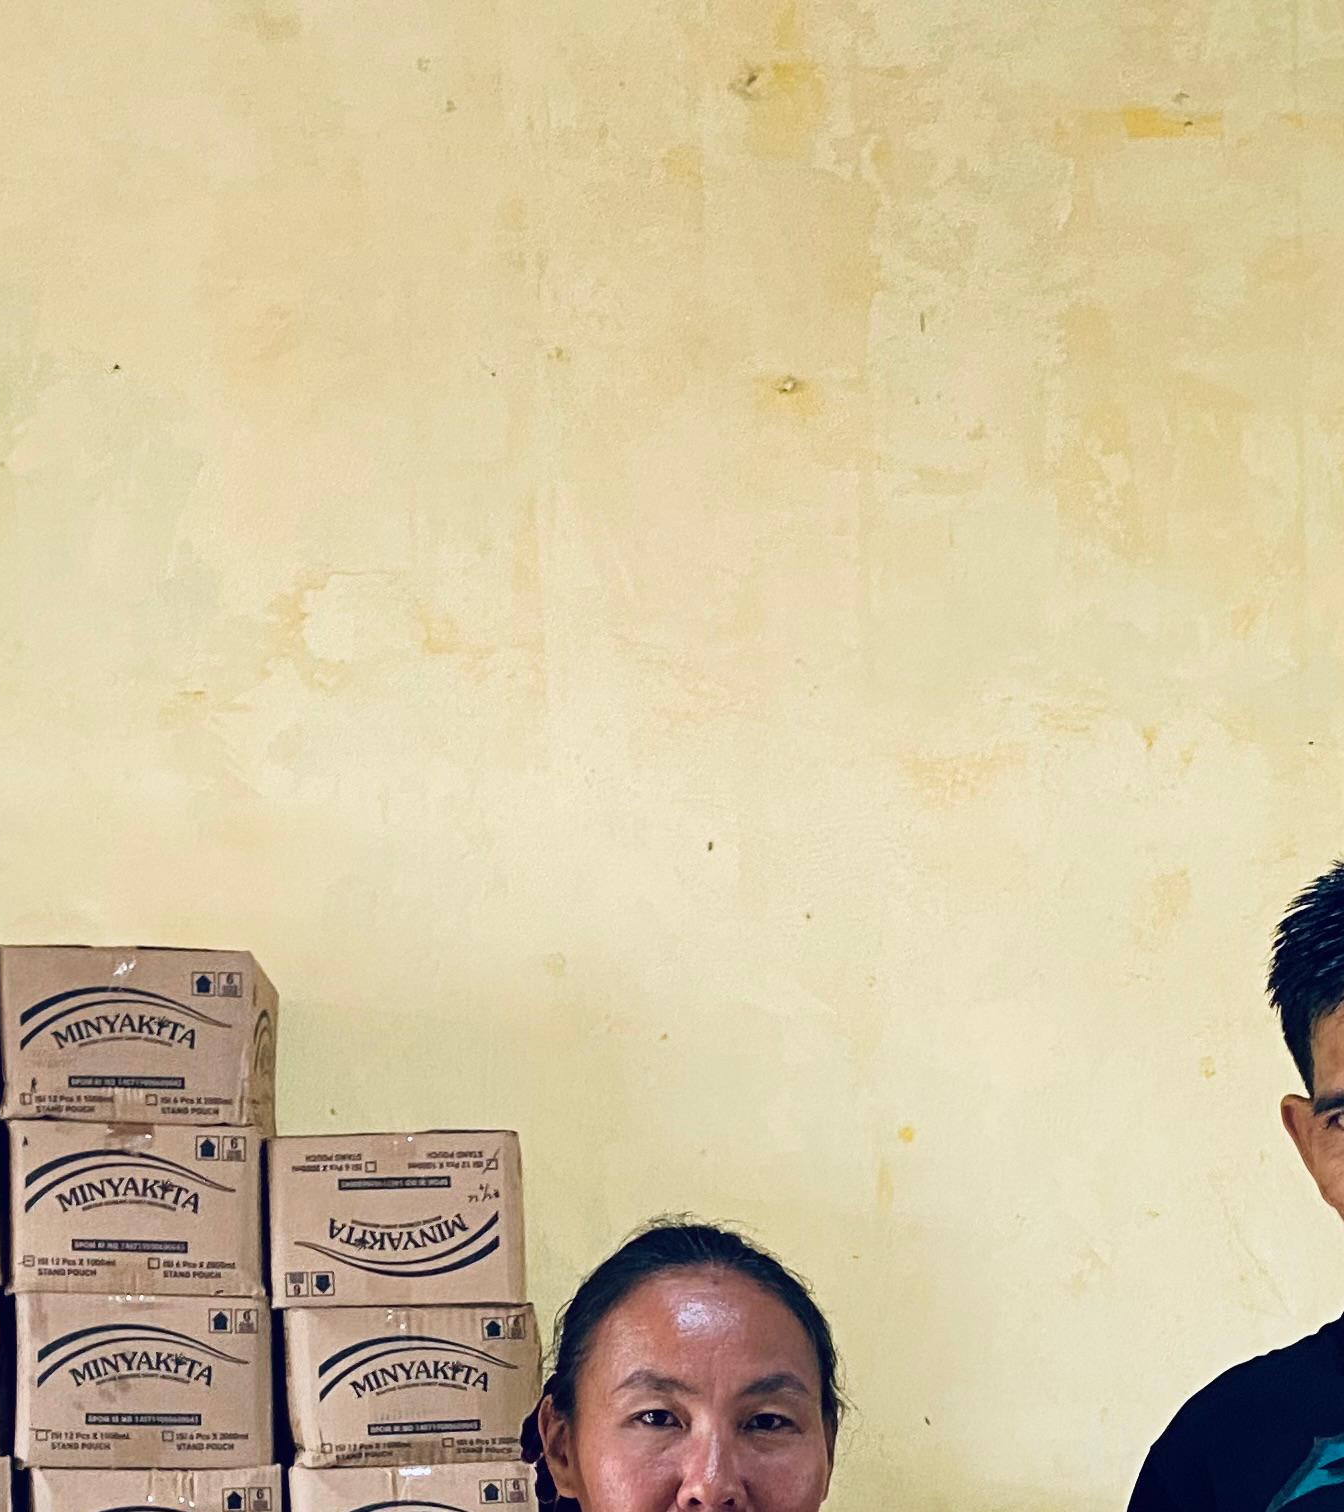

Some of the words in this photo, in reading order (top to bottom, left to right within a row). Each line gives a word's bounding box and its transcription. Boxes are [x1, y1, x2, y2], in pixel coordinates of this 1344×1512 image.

[51, 1013, 195, 1049] MINYAKITA
[56, 1177, 200, 1213] MINYAKITA
[329, 1213, 469, 1251] MINYAKITA
[38, 1268, 65, 1276] STAND
[68, 1269, 96, 1277] POUCH
[193, 1271, 221, 1279] POUCH
[69, 1351, 212, 1387] MINYAKITA
[350, 1360, 488, 1399] MINYAKITA
